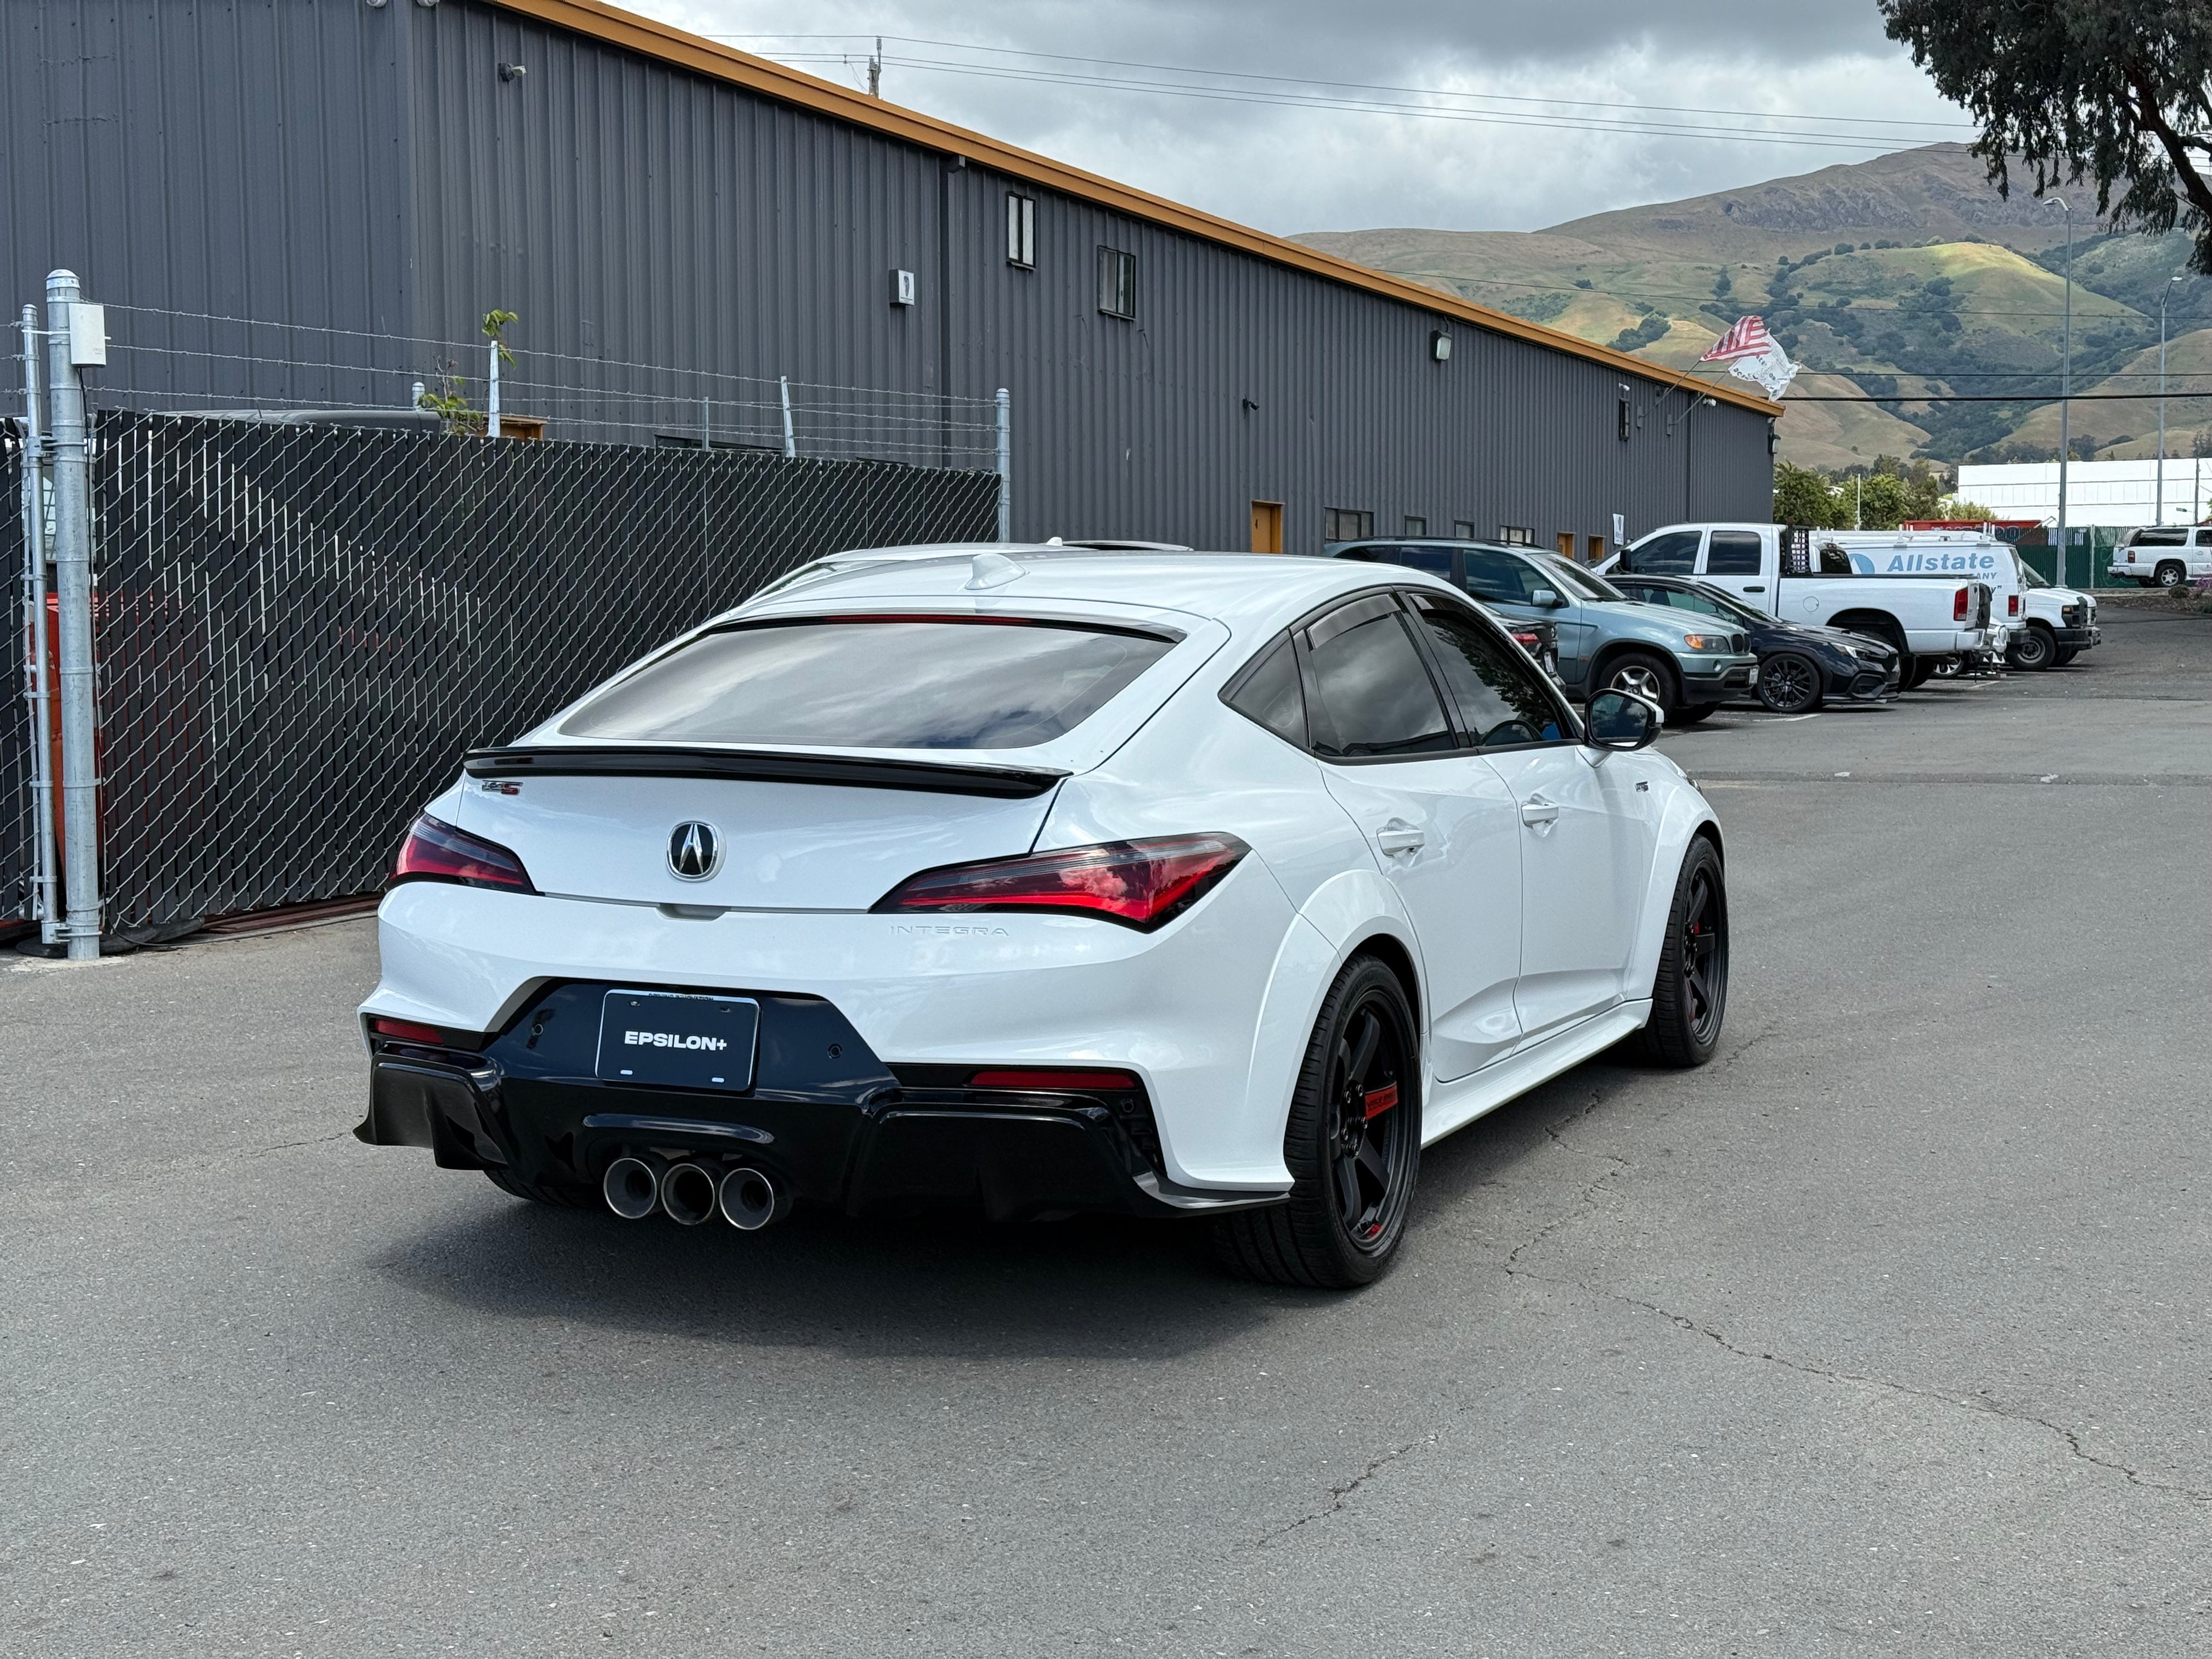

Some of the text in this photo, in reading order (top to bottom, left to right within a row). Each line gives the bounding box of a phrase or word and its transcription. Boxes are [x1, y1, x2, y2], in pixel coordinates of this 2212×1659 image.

[1887, 553, 1995, 572] Allstate
[890, 926, 1009, 936] INTEGRA
[624, 1030, 727, 1051] EPSILON+
